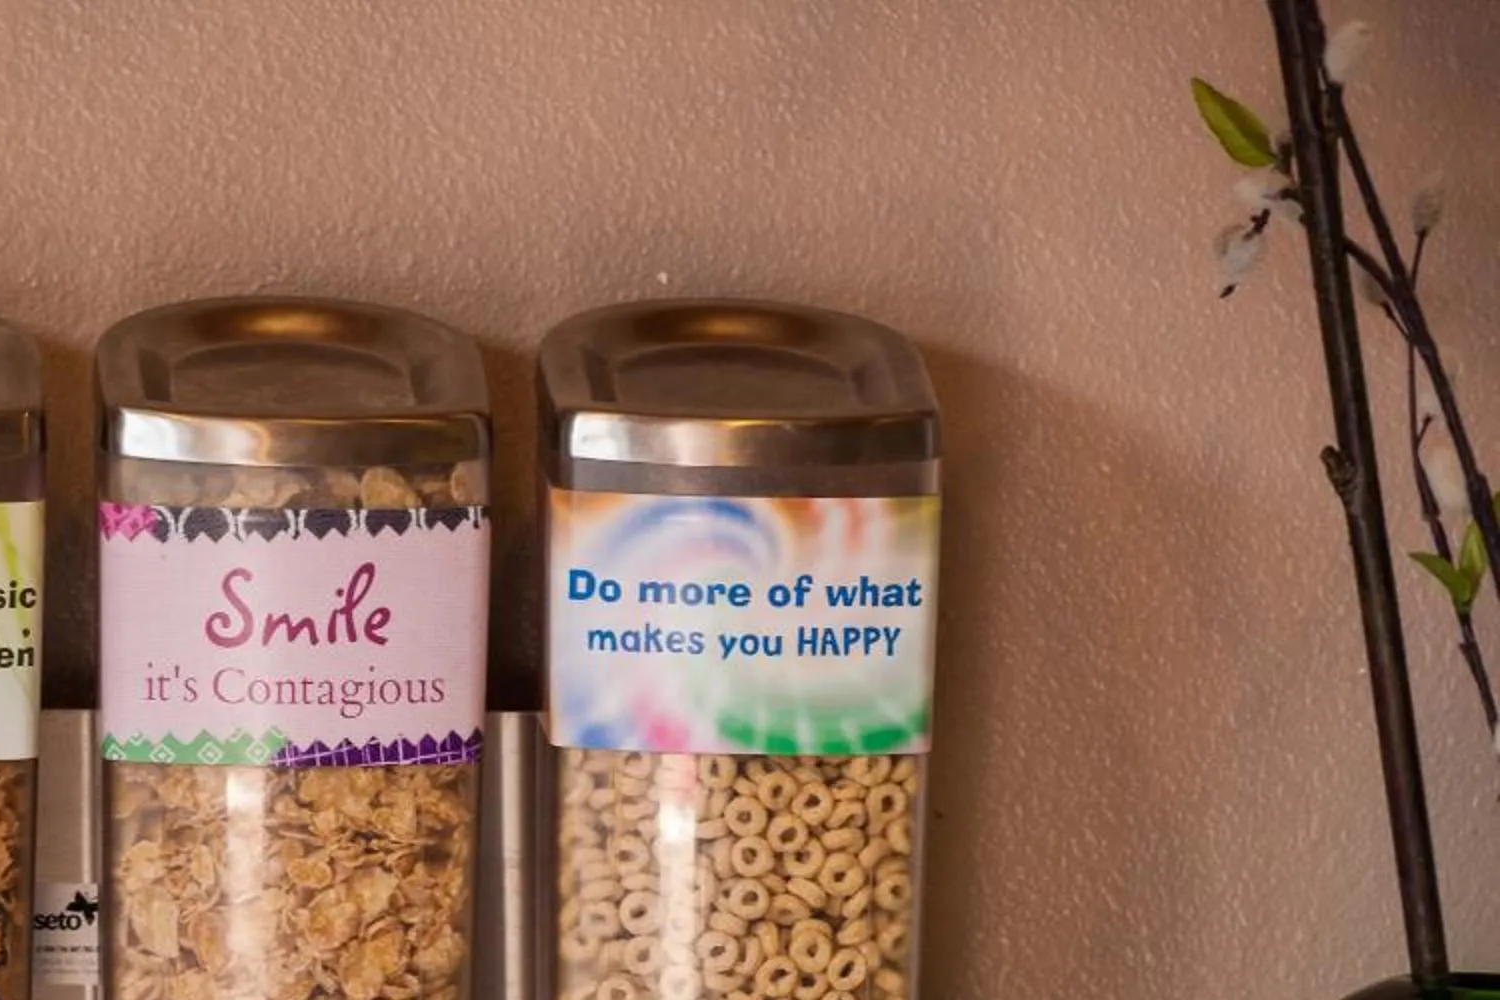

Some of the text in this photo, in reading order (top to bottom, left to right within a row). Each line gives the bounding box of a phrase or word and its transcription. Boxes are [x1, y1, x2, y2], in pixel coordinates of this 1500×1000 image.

[204, 561, 392, 649] Smile
[568, 568, 923, 607] Do more of what
[587, 622, 902, 660] makes you HAPPY
[144, 661, 446, 719] it's Contagious
